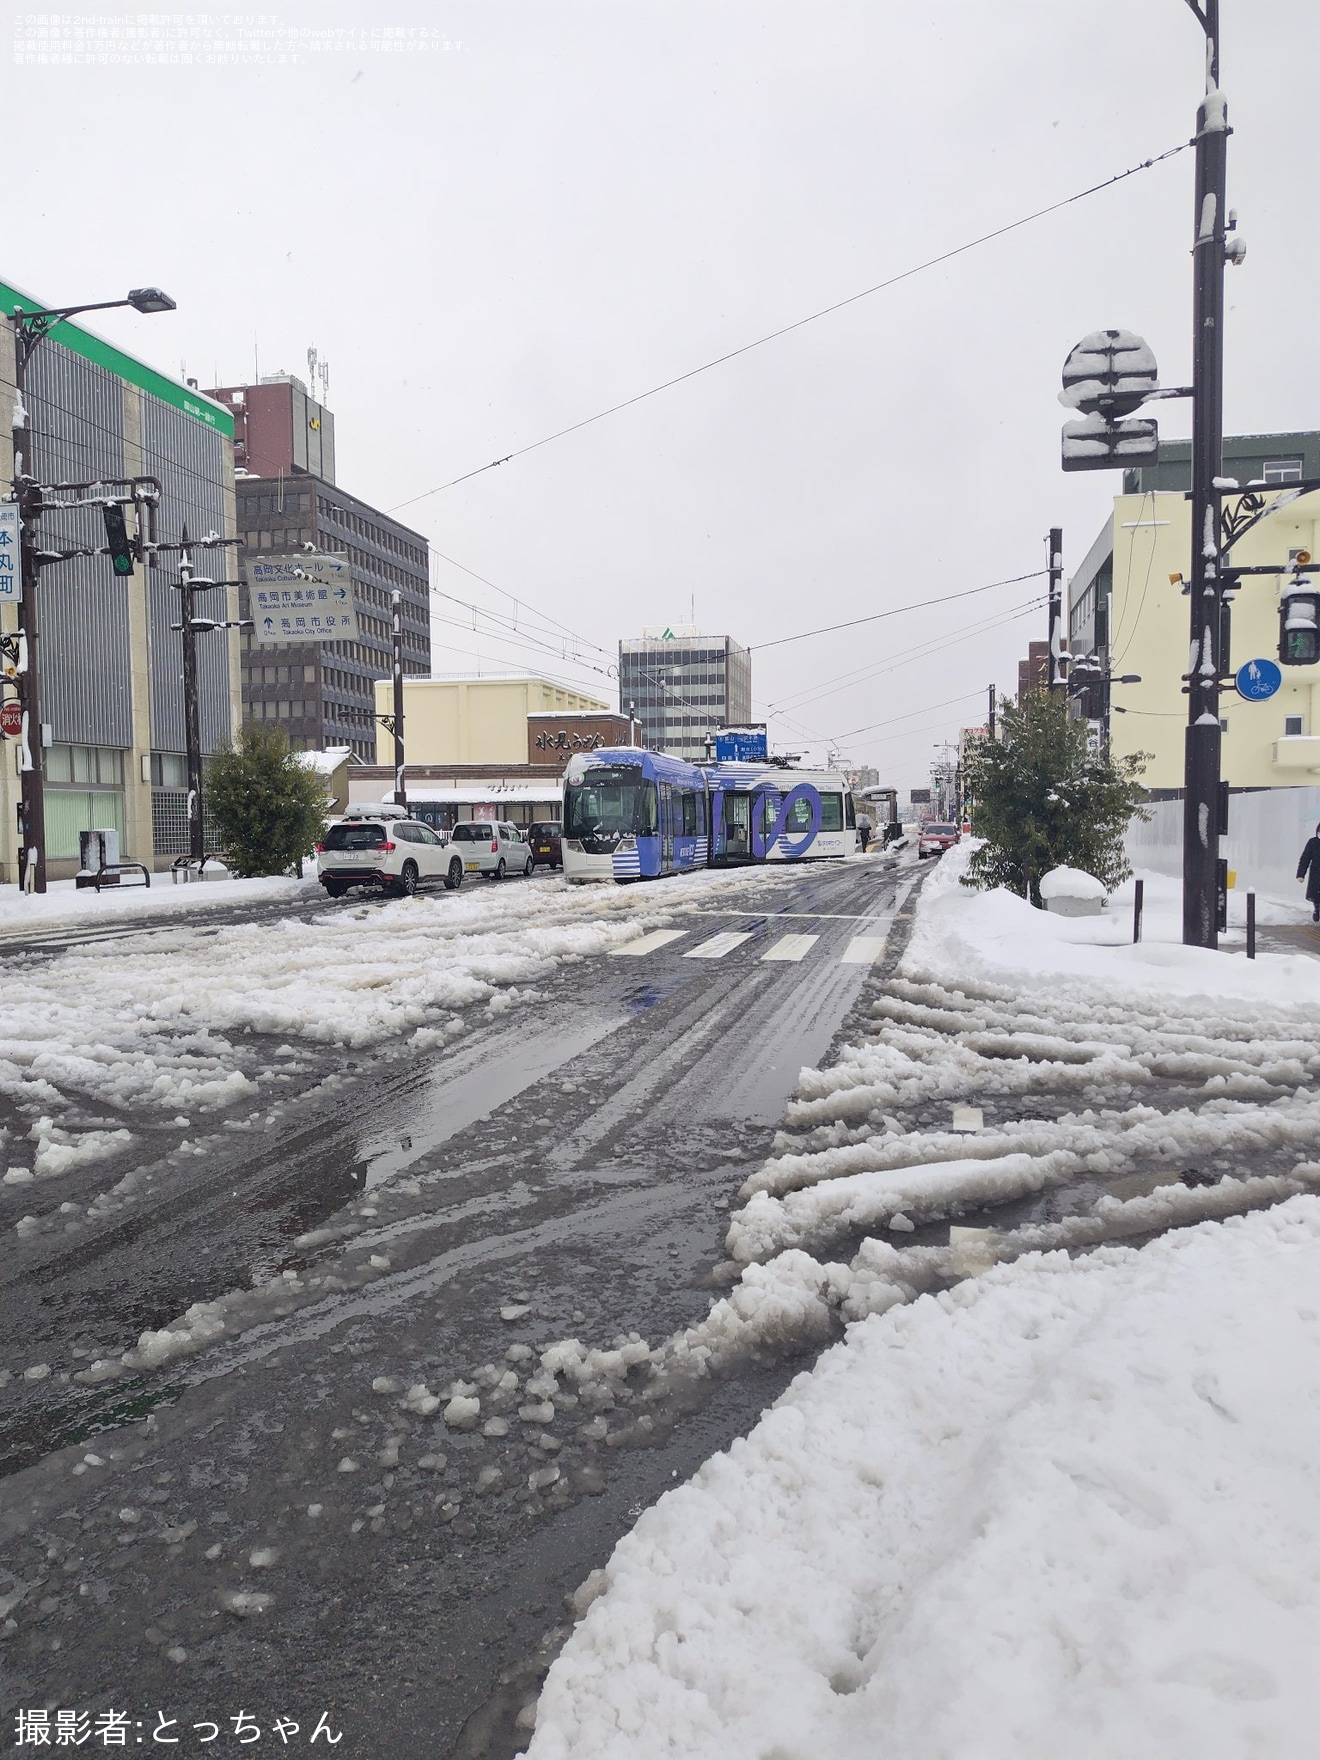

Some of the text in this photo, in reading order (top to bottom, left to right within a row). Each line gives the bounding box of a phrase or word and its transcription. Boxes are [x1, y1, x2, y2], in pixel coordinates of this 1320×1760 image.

[253, 562, 324, 576] 高岡文化ホール
[257, 589, 328, 603] 高岡市美術館
[290, 601, 313, 609] Museum
[281, 615, 351, 629] 高岡市役所
